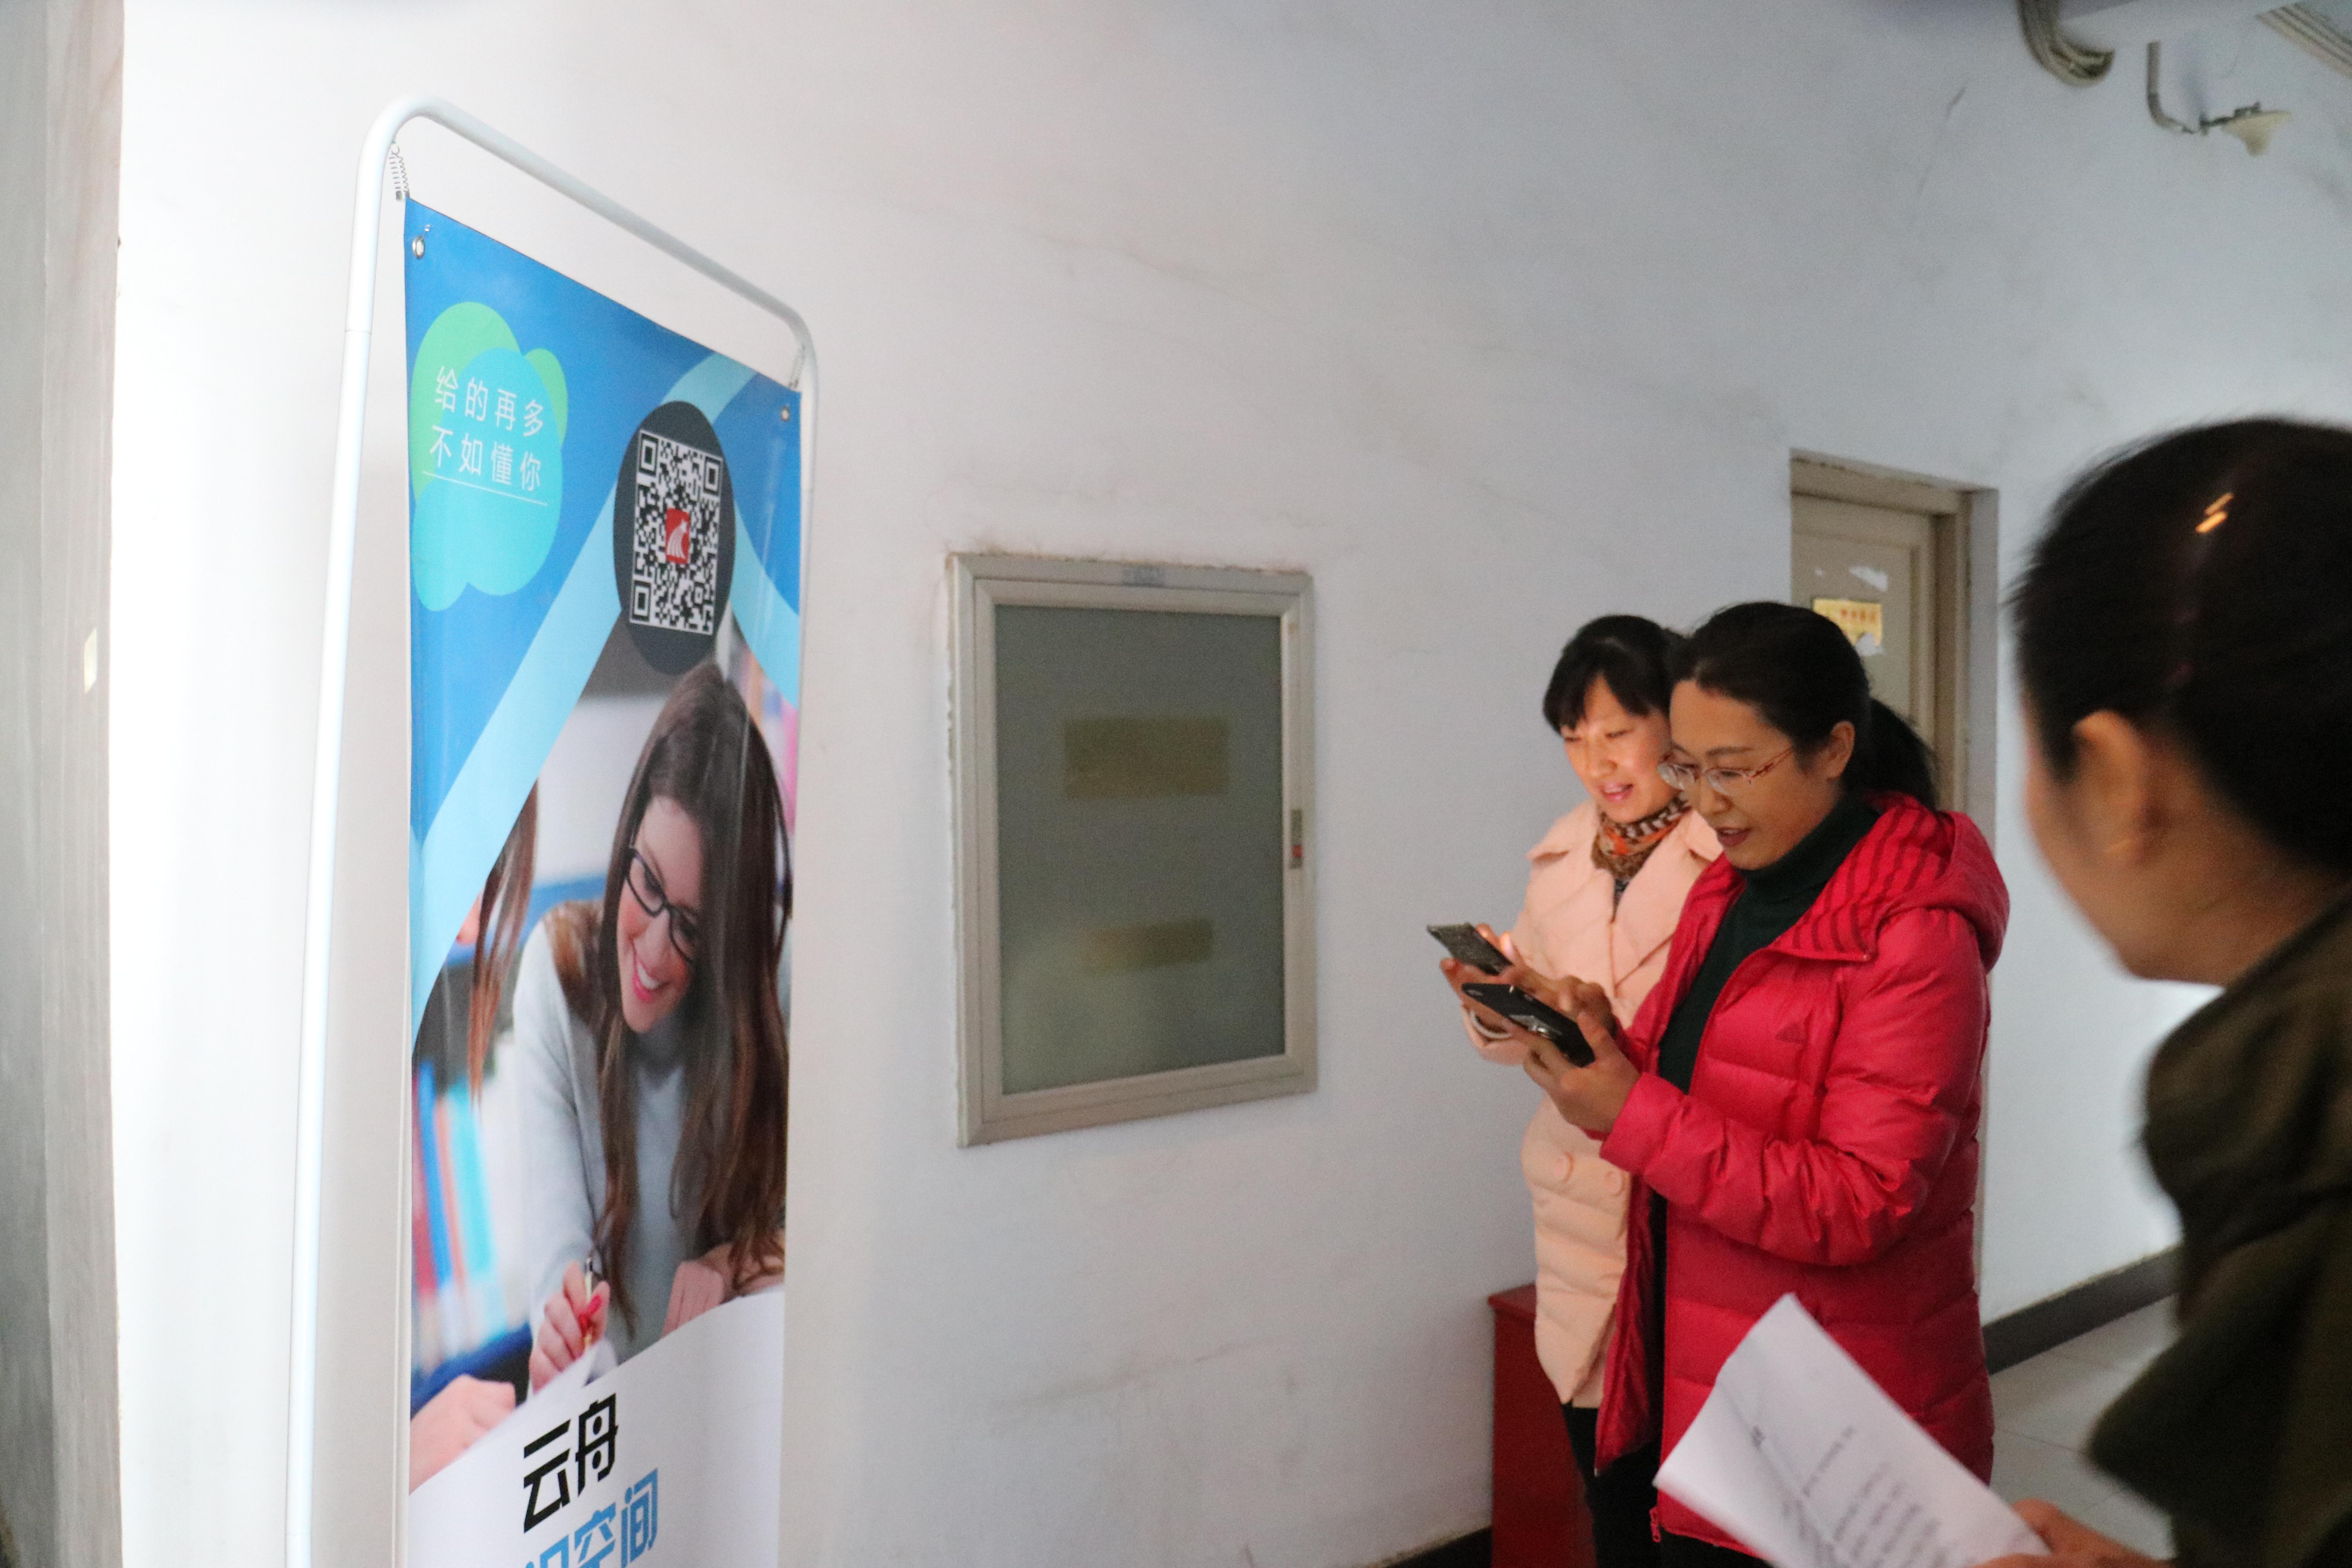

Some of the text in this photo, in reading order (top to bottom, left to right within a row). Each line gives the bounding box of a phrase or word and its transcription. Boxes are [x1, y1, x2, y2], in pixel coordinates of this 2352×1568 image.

[434, 365, 544, 437] 给的再多
[429, 425, 541, 492] 不如懂你
[524, 1392, 618, 1533] 云舟
[525, 1468, 658, 1568] 空间
